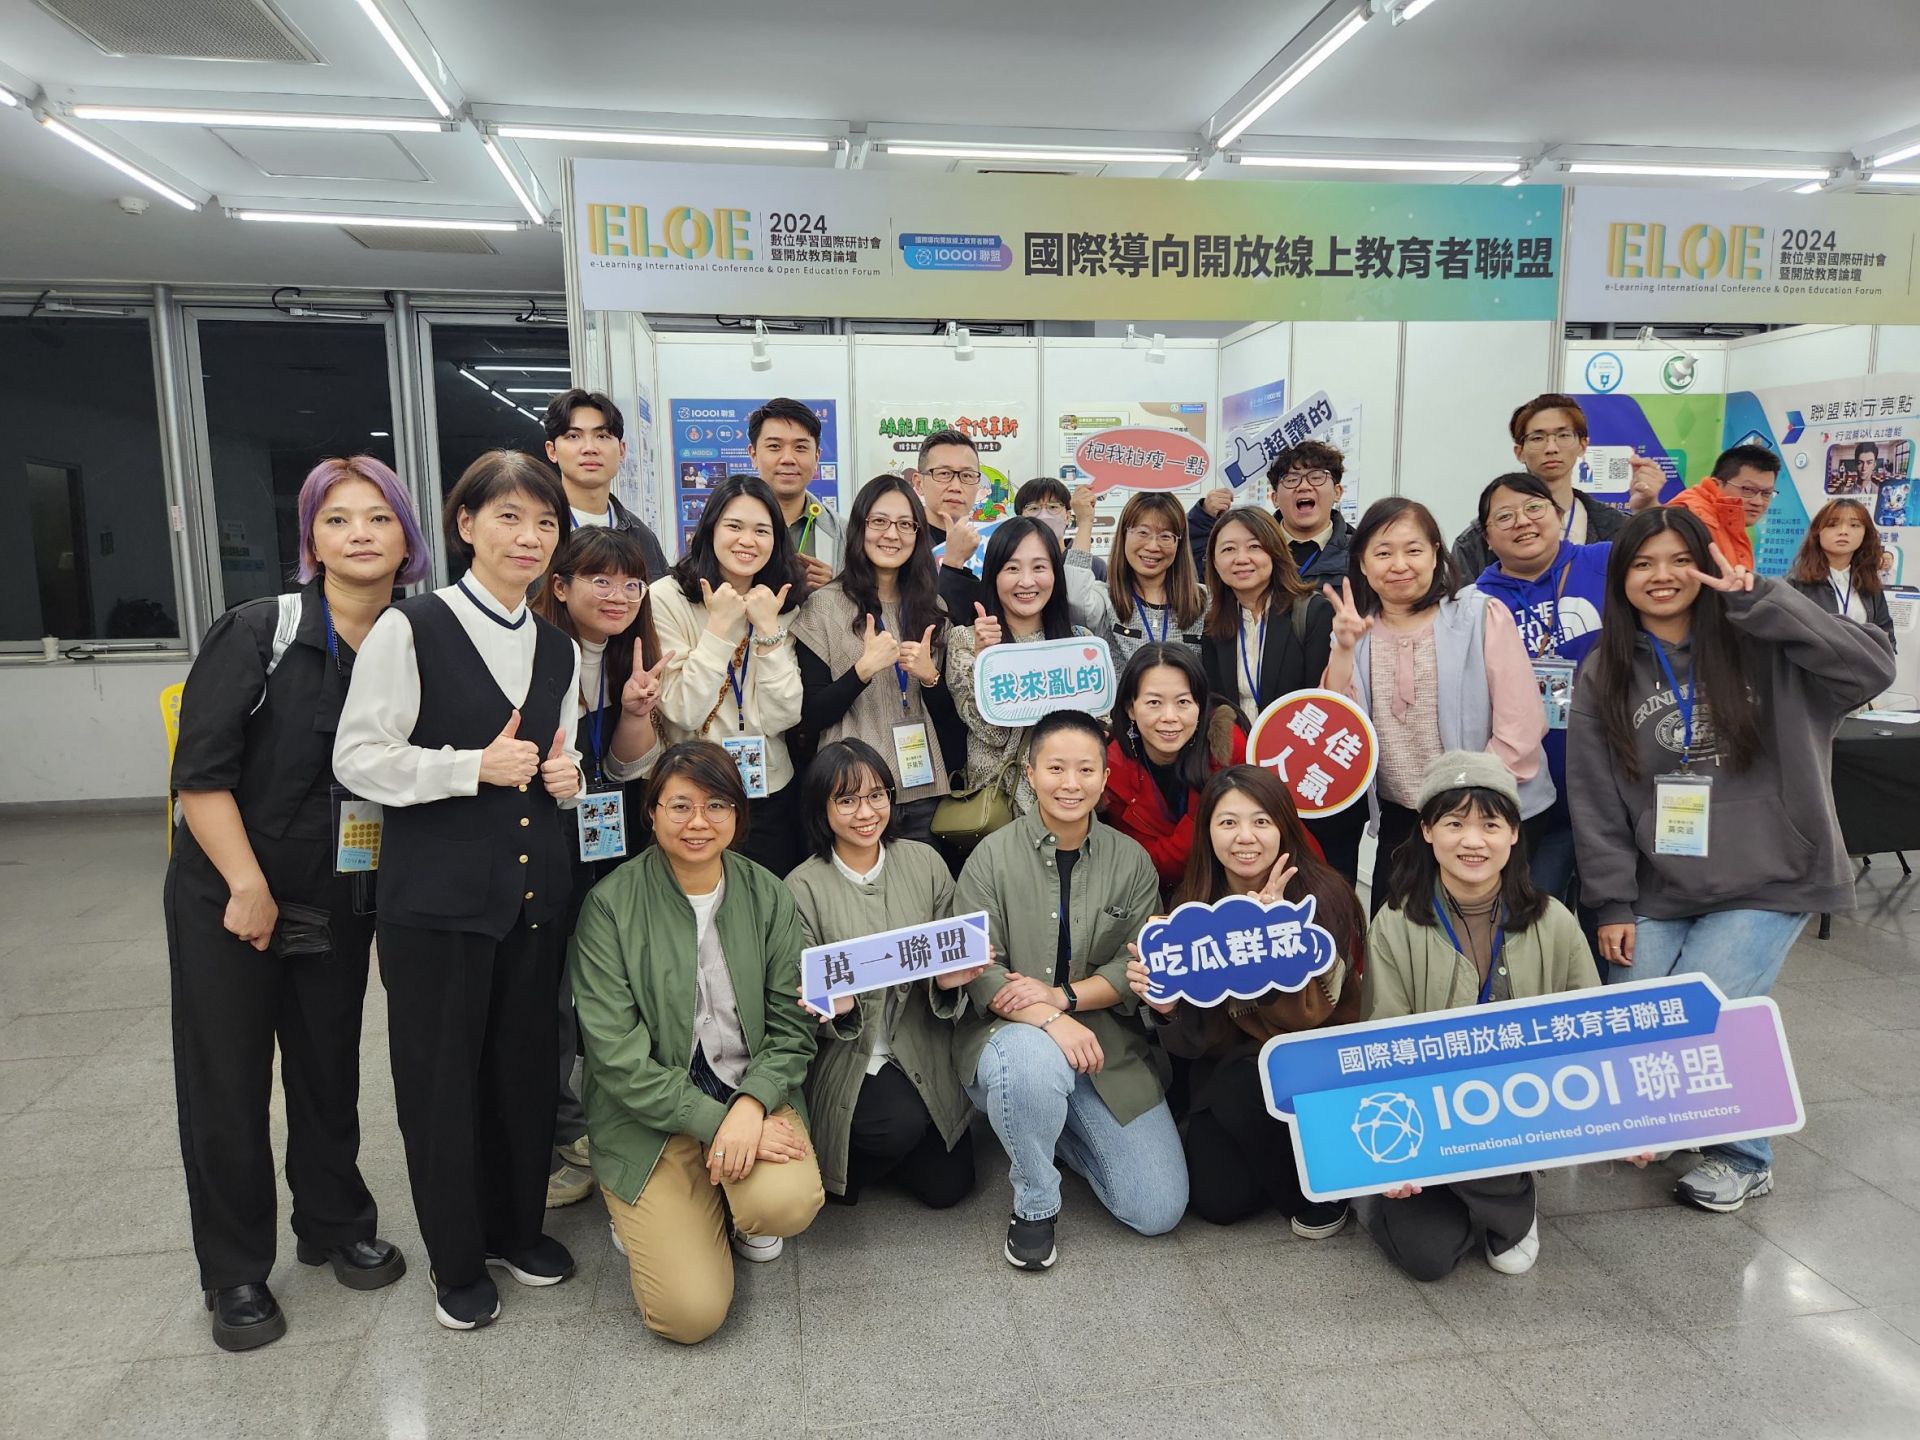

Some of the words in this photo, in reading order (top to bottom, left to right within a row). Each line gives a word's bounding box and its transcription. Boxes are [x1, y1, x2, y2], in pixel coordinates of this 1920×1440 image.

[587, 204, 753, 260] ELOE
[770, 213, 827, 234] 2024
[770, 234, 881, 249] 數位學習國際研討會
[1781, 229, 1837, 251] 2024
[590, 260, 642, 270] e-Learning
[645, 261, 708, 271] International
[712, 263, 764, 273] Conference
[767, 265, 774, 273] &
[777, 265, 800, 275] Open
[804, 266, 849, 275] Education
[852, 267, 880, 276] Forum
[771, 248, 857, 263] 暨開放教育論壇
[1024, 231, 1554, 280] 國際導向開放線上教育者聯盟
[1606, 222, 1764, 280] ELOE
[1779, 251, 1887, 267] 數位學習國際研討會
[1605, 283, 1654, 293] e-Learning
[1657, 283, 1718, 293] International
[1721, 284, 1771, 293] Conference
[1783, 285, 1805, 295] Open
[1808, 286, 1852, 295] Education
[1855, 287, 1882, 295] Forum
[1779, 266, 1862, 282] 暨開放教育論壇
[1810, 394, 1914, 421] 聯盟執行亮點
[1085, 440, 1207, 476] 把我拍瘦一點
[988, 664, 1104, 703] 我來亂的
[1286, 702, 1363, 770] 最佳
[1259, 745, 1335, 807] 人氣
[819, 927, 970, 990] 萬一聯盟
[1149, 920, 1307, 977] 吃瓜群眾
[1337, 997, 1690, 1077] 國際導向開放線上教育者聯盟
[1629, 1044, 1733, 1103] 聯盟
[1440, 1134, 1523, 1156] International
[1525, 1125, 1583, 1143] Oriented
[1585, 1120, 1621, 1138] Open
[1624, 1111, 1667, 1130] Online
[1668, 1103, 1741, 1124] Instructors
